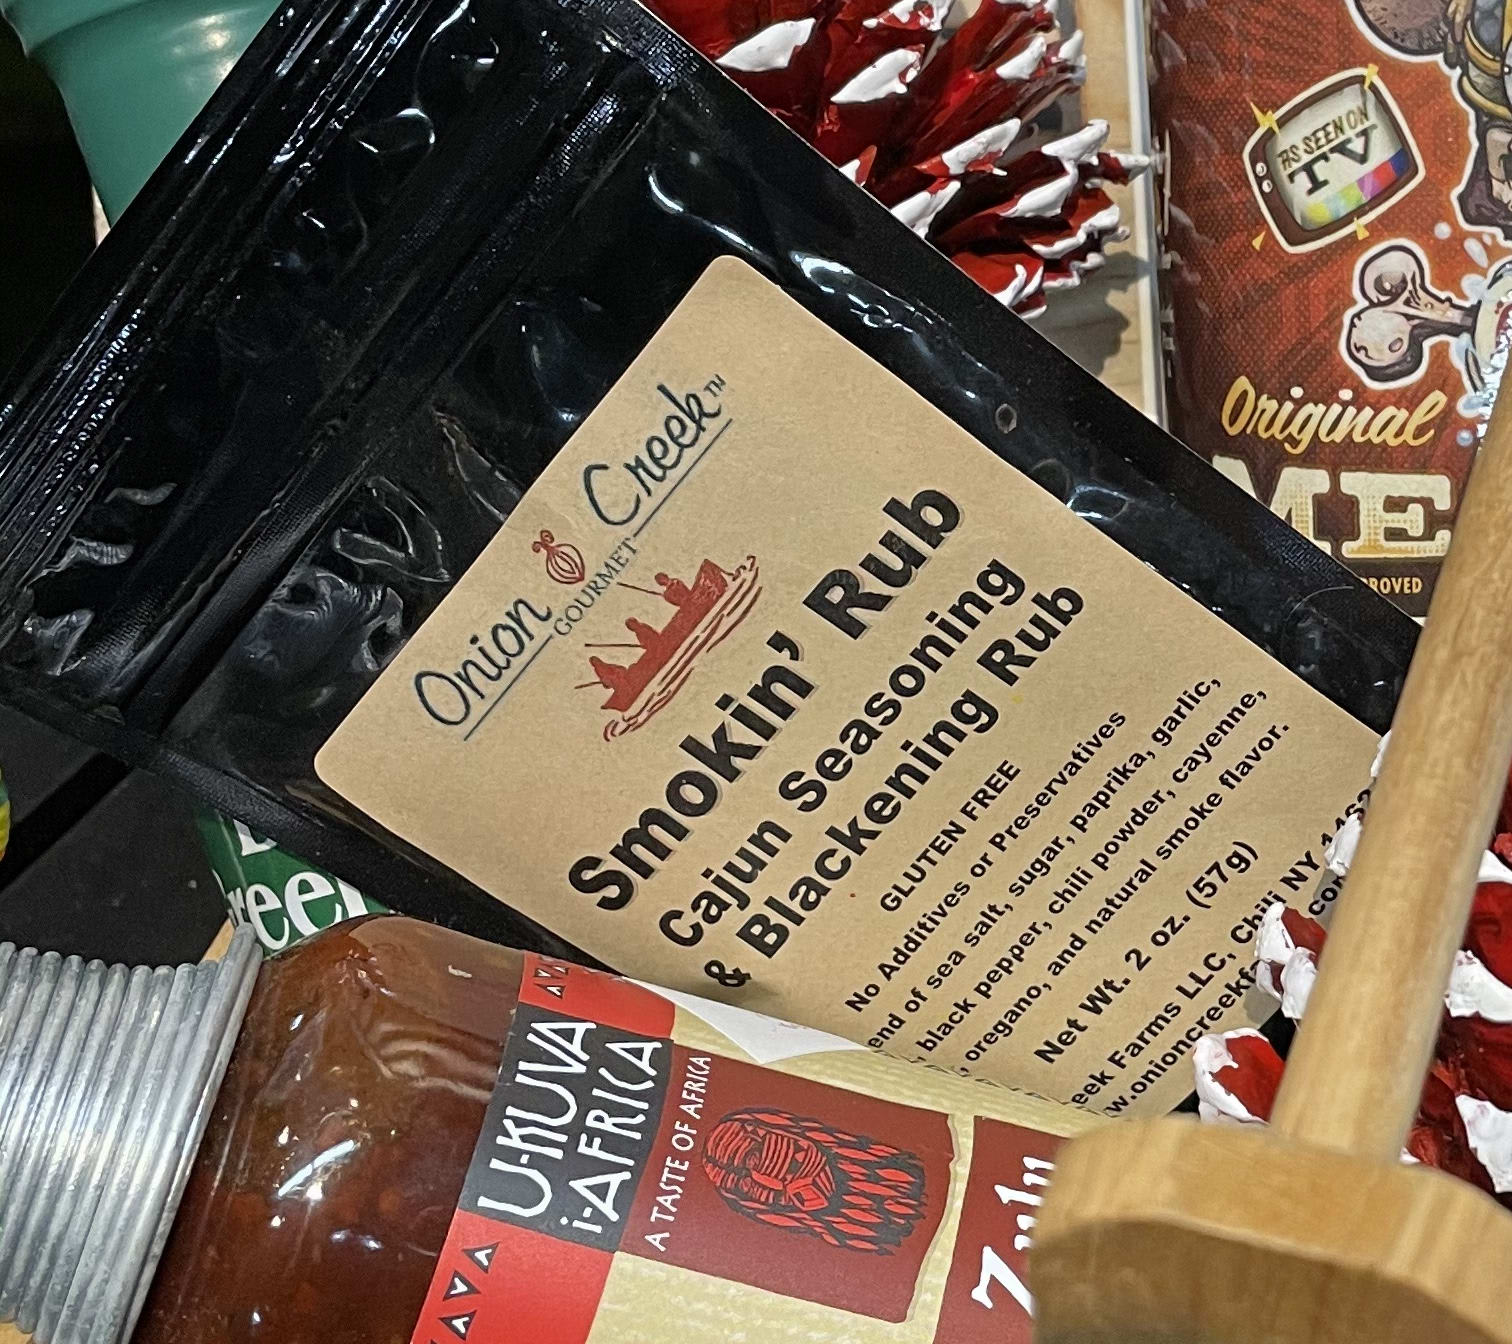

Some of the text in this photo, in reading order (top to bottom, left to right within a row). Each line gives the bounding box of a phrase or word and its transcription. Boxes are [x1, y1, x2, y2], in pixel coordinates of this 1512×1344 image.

[1286, 123, 1378, 196] TV
[1302, 115, 1346, 155] SEEN
[1220, 375, 1448, 455] Original
[414, 598, 552, 727] Onion
[552, 537, 638, 636] GOURMET
[567, 488, 962, 912] Smokin' Rub
[658, 557, 1027, 948] Cajun Seasoning
[704, 585, 1085, 989] & Blackening Rub
[844, 710, 1127, 1013] No Additives or Preservatives
[867, 677, 1222, 1049] end of sea salt, sugar, paprika, garlic,
[879, 759, 1022, 912] GLUTEN FREE
[916, 690, 1268, 1052] black pepper, chili powder, cayenne,
[964, 723, 1291, 1063] oregano, and natural smoke flavor.
[1033, 840, 1260, 1065] Net Wt. 2 oz. (57g)
[1071, 1065, 1116, 1107] eek
[1107, 1001, 1183, 1071] Farms
[1175, 951, 1238, 1001] LLC,
[1279, 850, 1321, 892] NY
[477, 1021, 597, 1218] U-KUVA
[644, 1056, 712, 1252] A TASTE OF AFRICA
